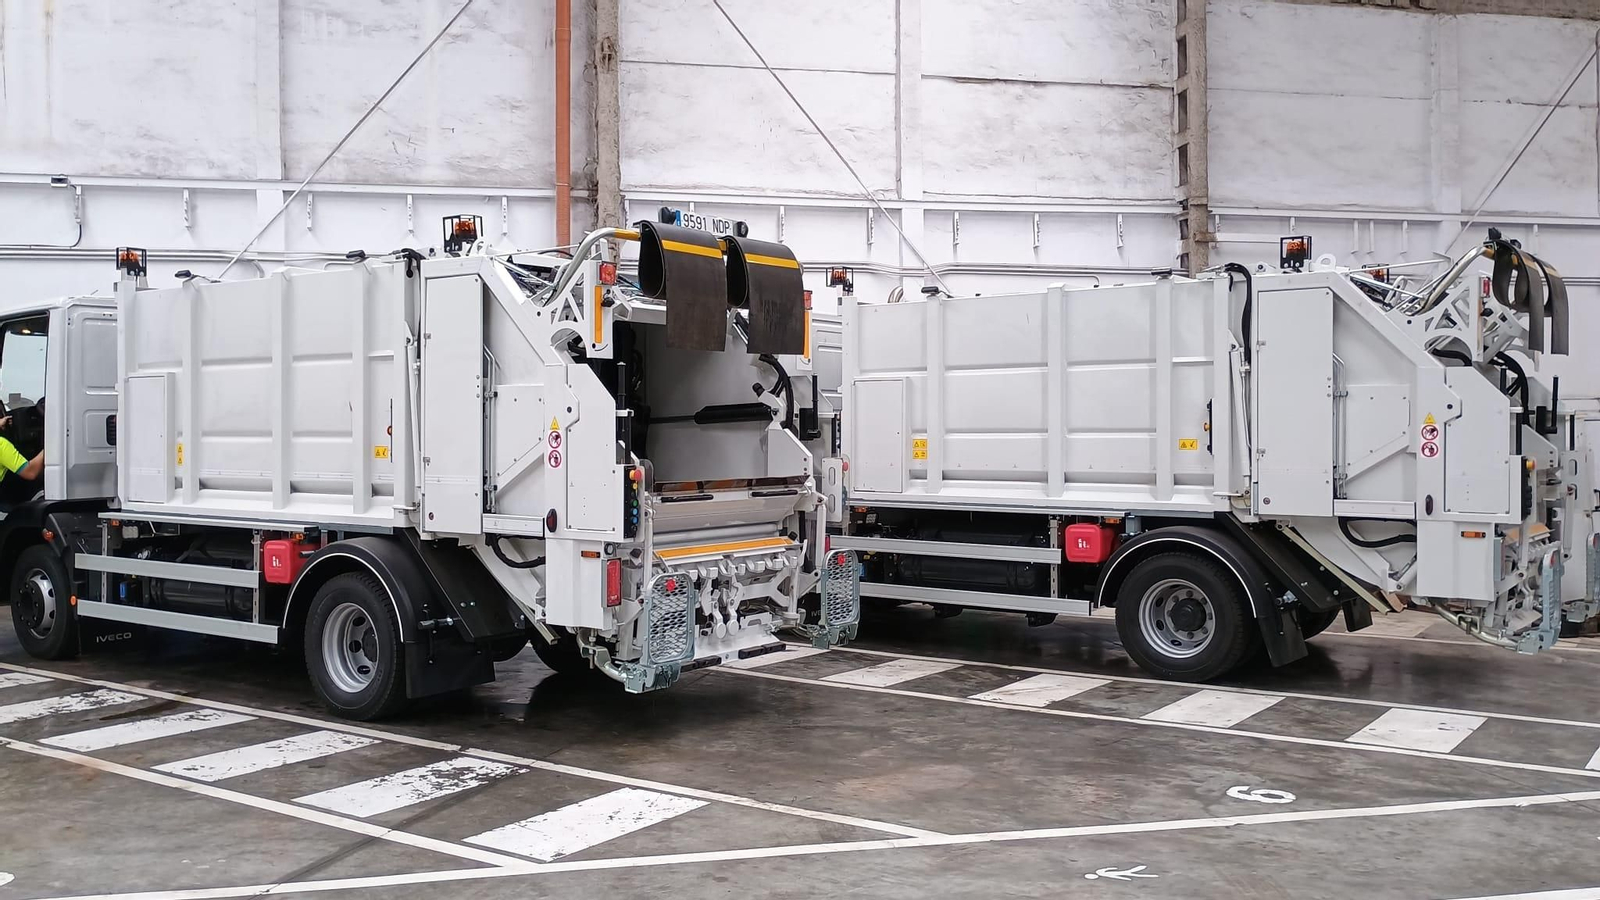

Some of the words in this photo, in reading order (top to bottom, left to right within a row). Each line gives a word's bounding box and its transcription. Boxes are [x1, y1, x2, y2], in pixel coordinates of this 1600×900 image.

[683, 213, 707, 231] 9591
[712, 218, 730, 234] NDP
[96, 632, 132, 643] IVECO
